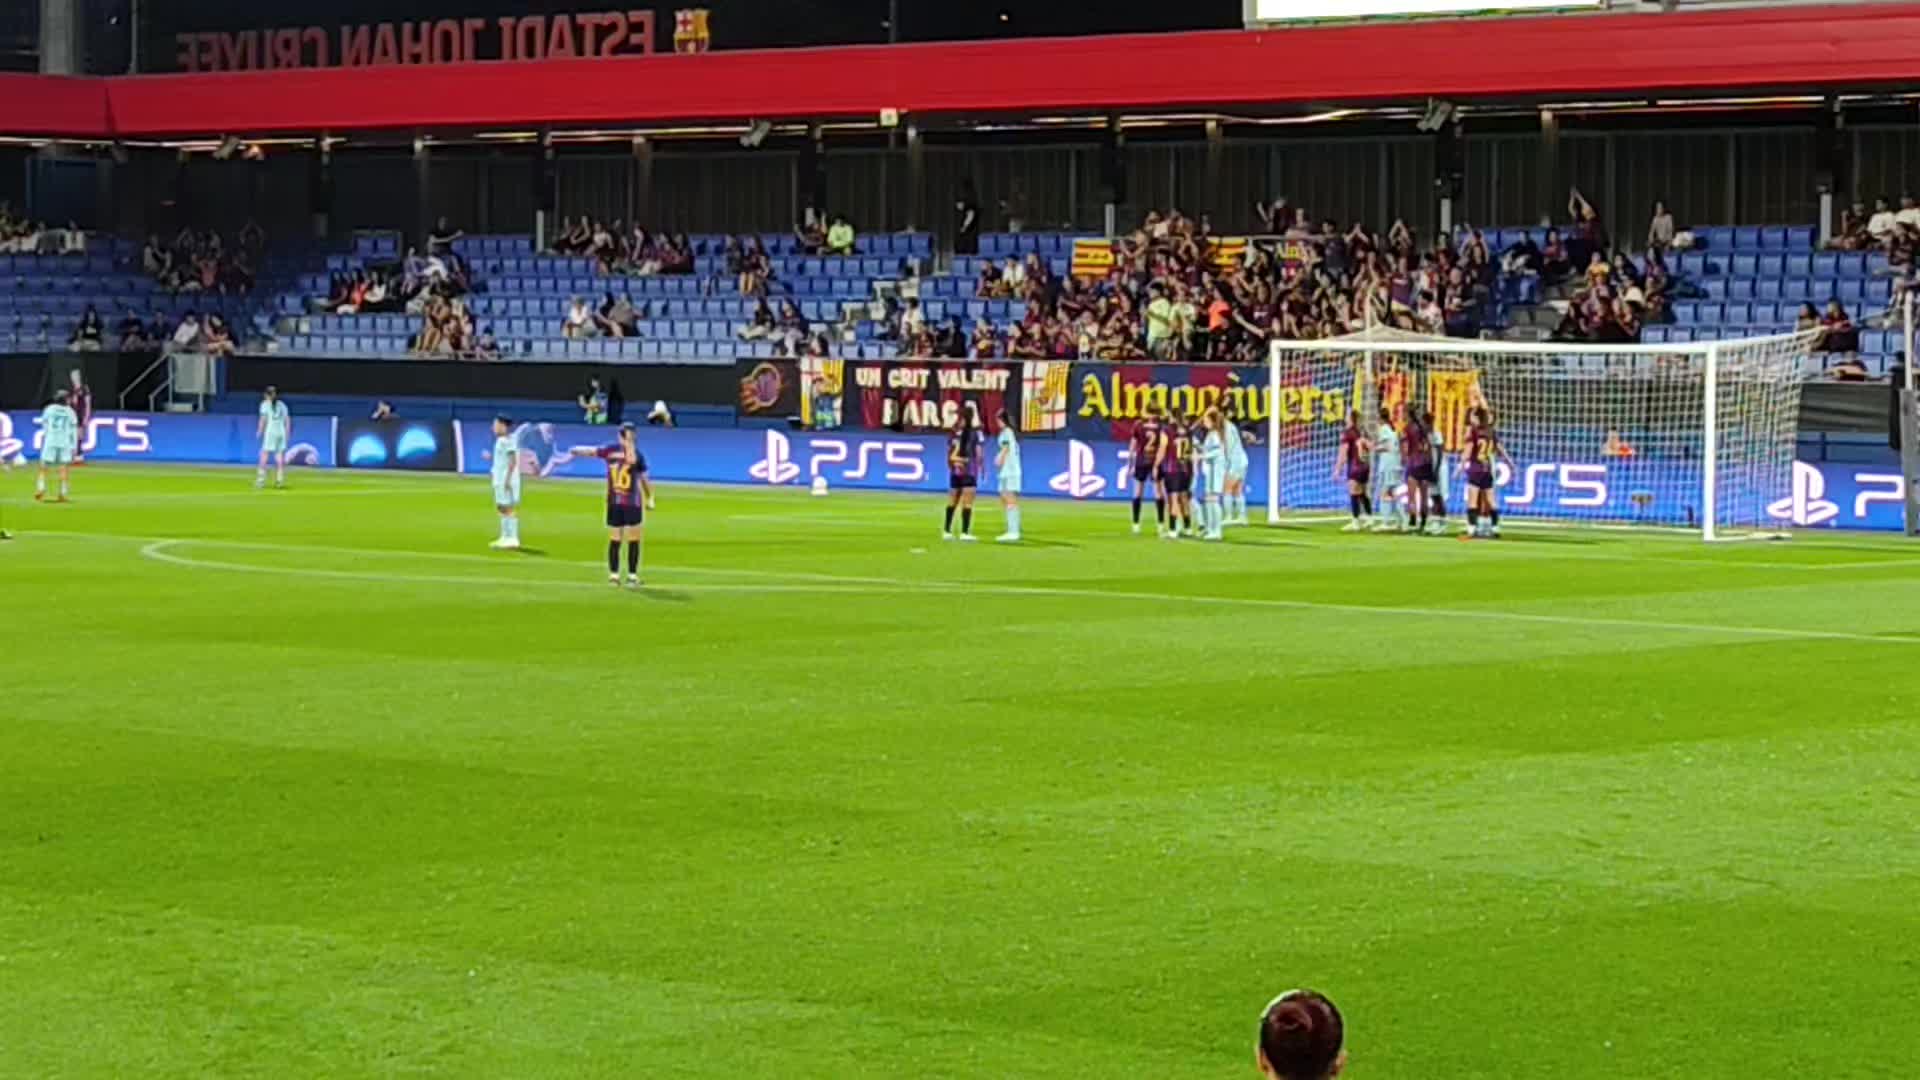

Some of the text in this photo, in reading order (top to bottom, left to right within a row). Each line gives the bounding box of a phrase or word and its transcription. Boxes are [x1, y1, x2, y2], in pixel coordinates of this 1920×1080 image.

[855, 367, 1011, 391] UN CRIT VALENT
[809, 440, 925, 480] PS5
[609, 464, 632, 489] 16
